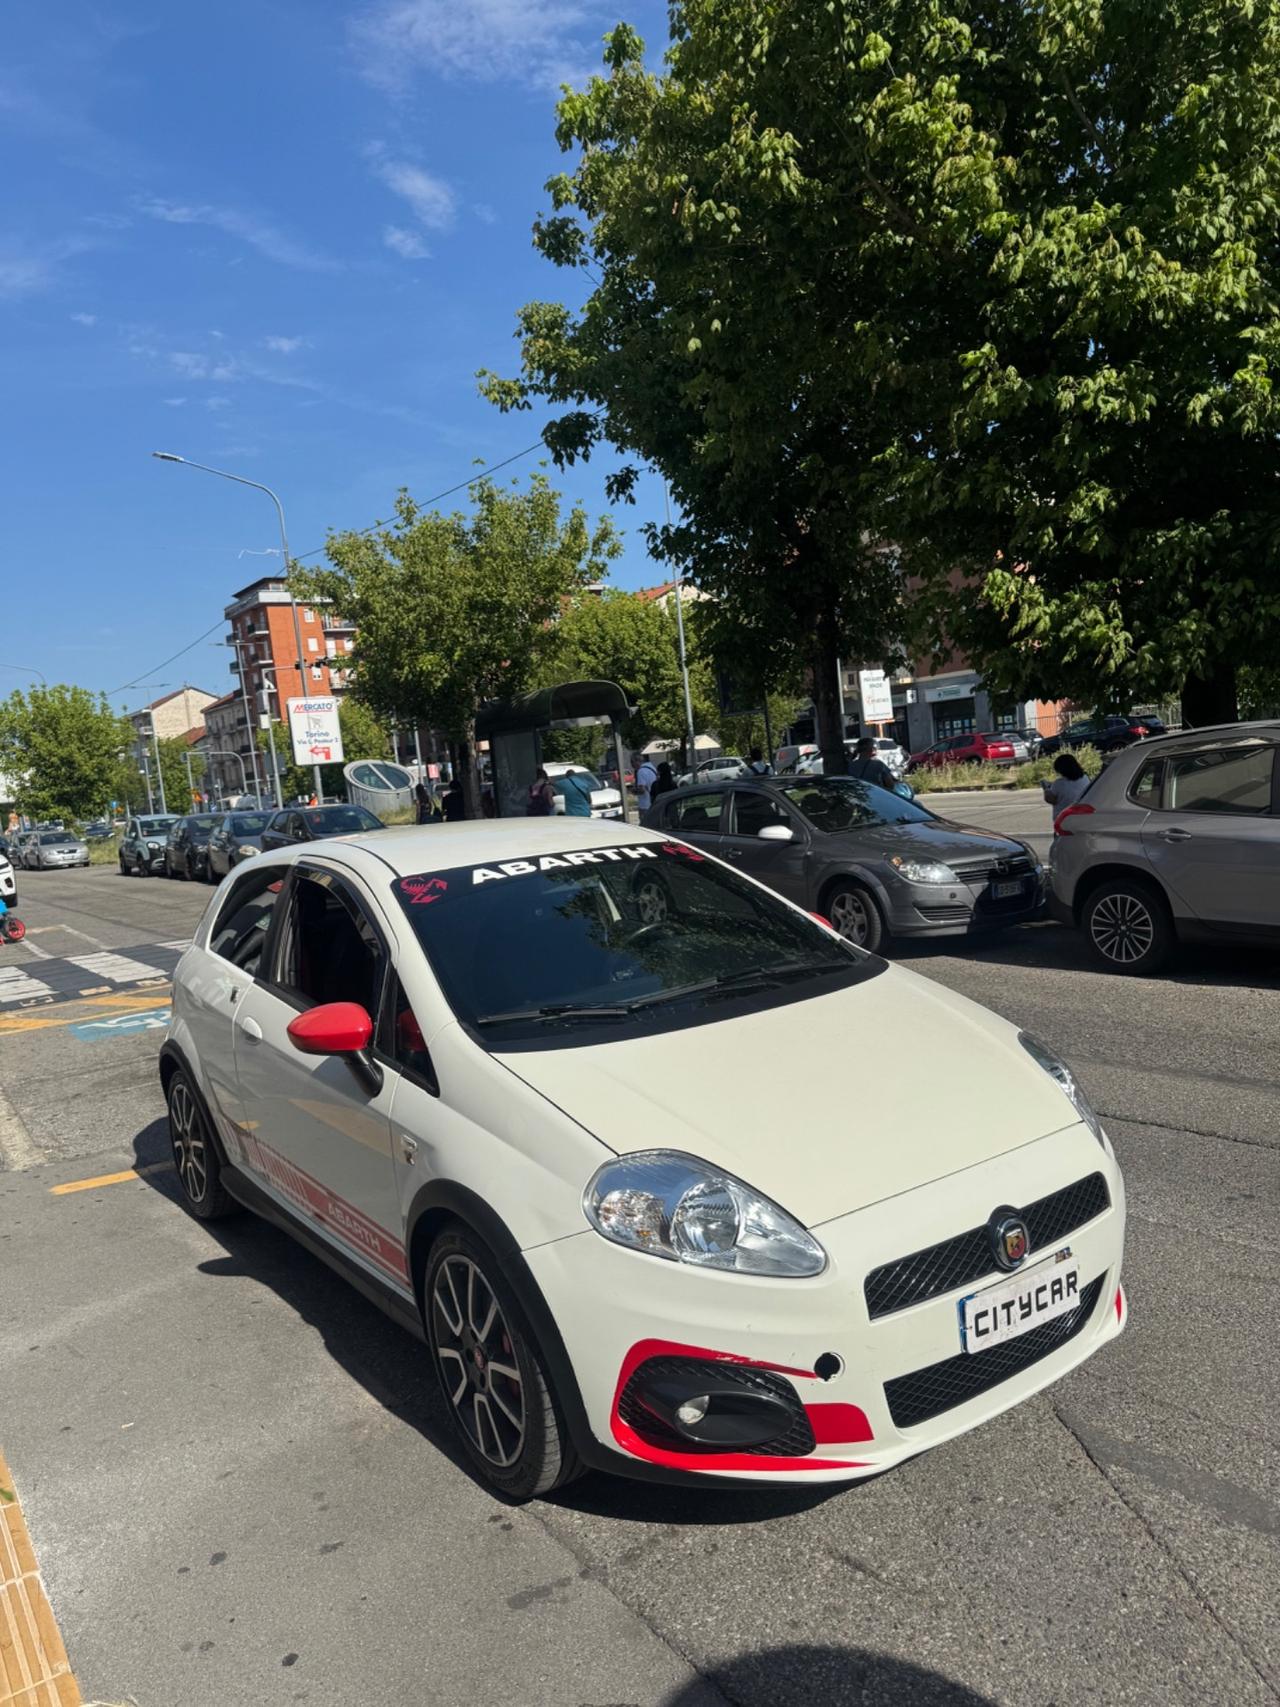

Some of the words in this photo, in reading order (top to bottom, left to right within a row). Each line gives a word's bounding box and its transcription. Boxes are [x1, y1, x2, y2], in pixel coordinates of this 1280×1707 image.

[294, 703, 332, 713] MERCATO
[305, 730, 329, 738] Torino
[472, 847, 657, 884] ABARTH
[328, 1201, 382, 1253] ABARTH
[974, 1270, 1078, 1338] CITYCAR
